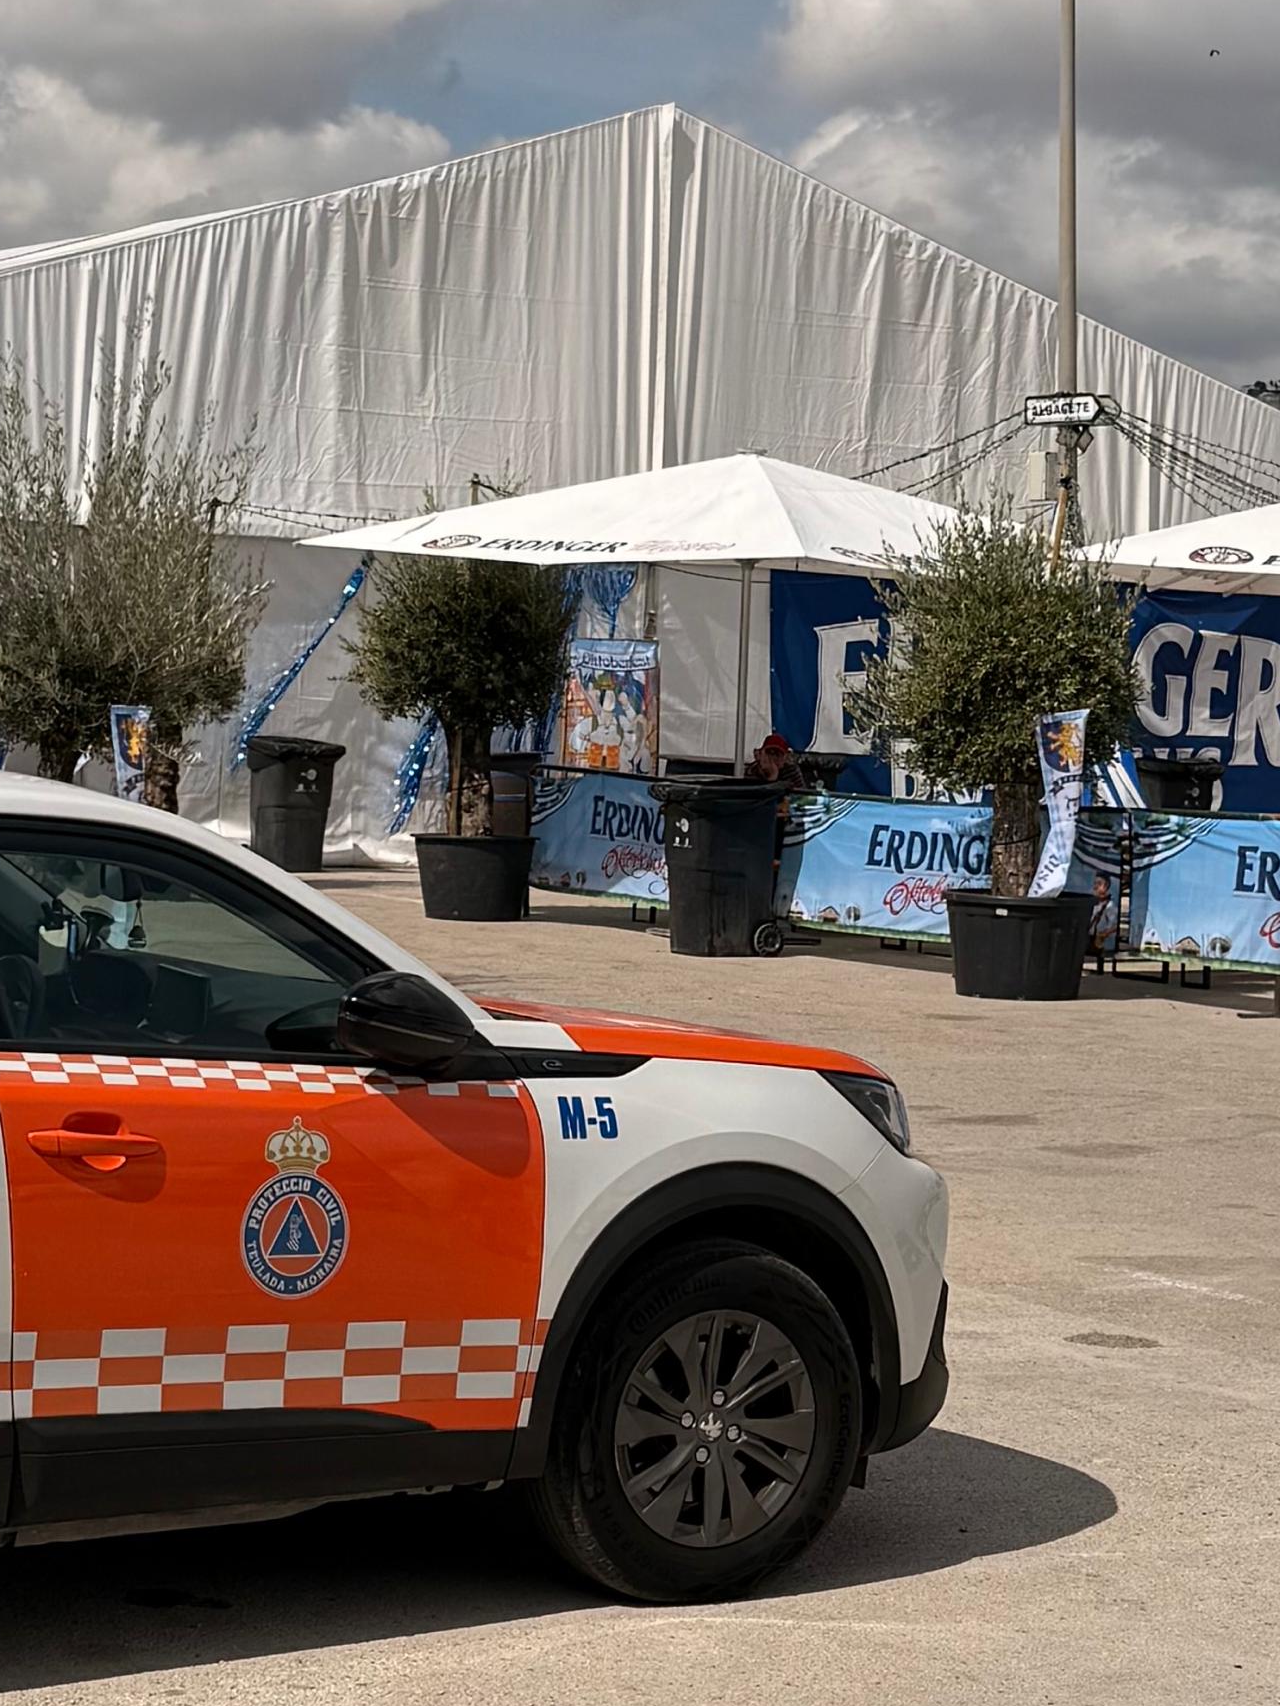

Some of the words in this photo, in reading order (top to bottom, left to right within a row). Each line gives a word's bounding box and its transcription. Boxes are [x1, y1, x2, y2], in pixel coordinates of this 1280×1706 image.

[479, 538, 628, 553] ERDINGER
[589, 795, 666, 845] ERDING
[864, 824, 993, 876] ERDING
[557, 1096, 619, 1139] M-5
[315, 1187, 343, 1227] CIVIL
[247, 1240, 286, 1292] TEULADA
[296, 1238, 344, 1292] MORAIRA
